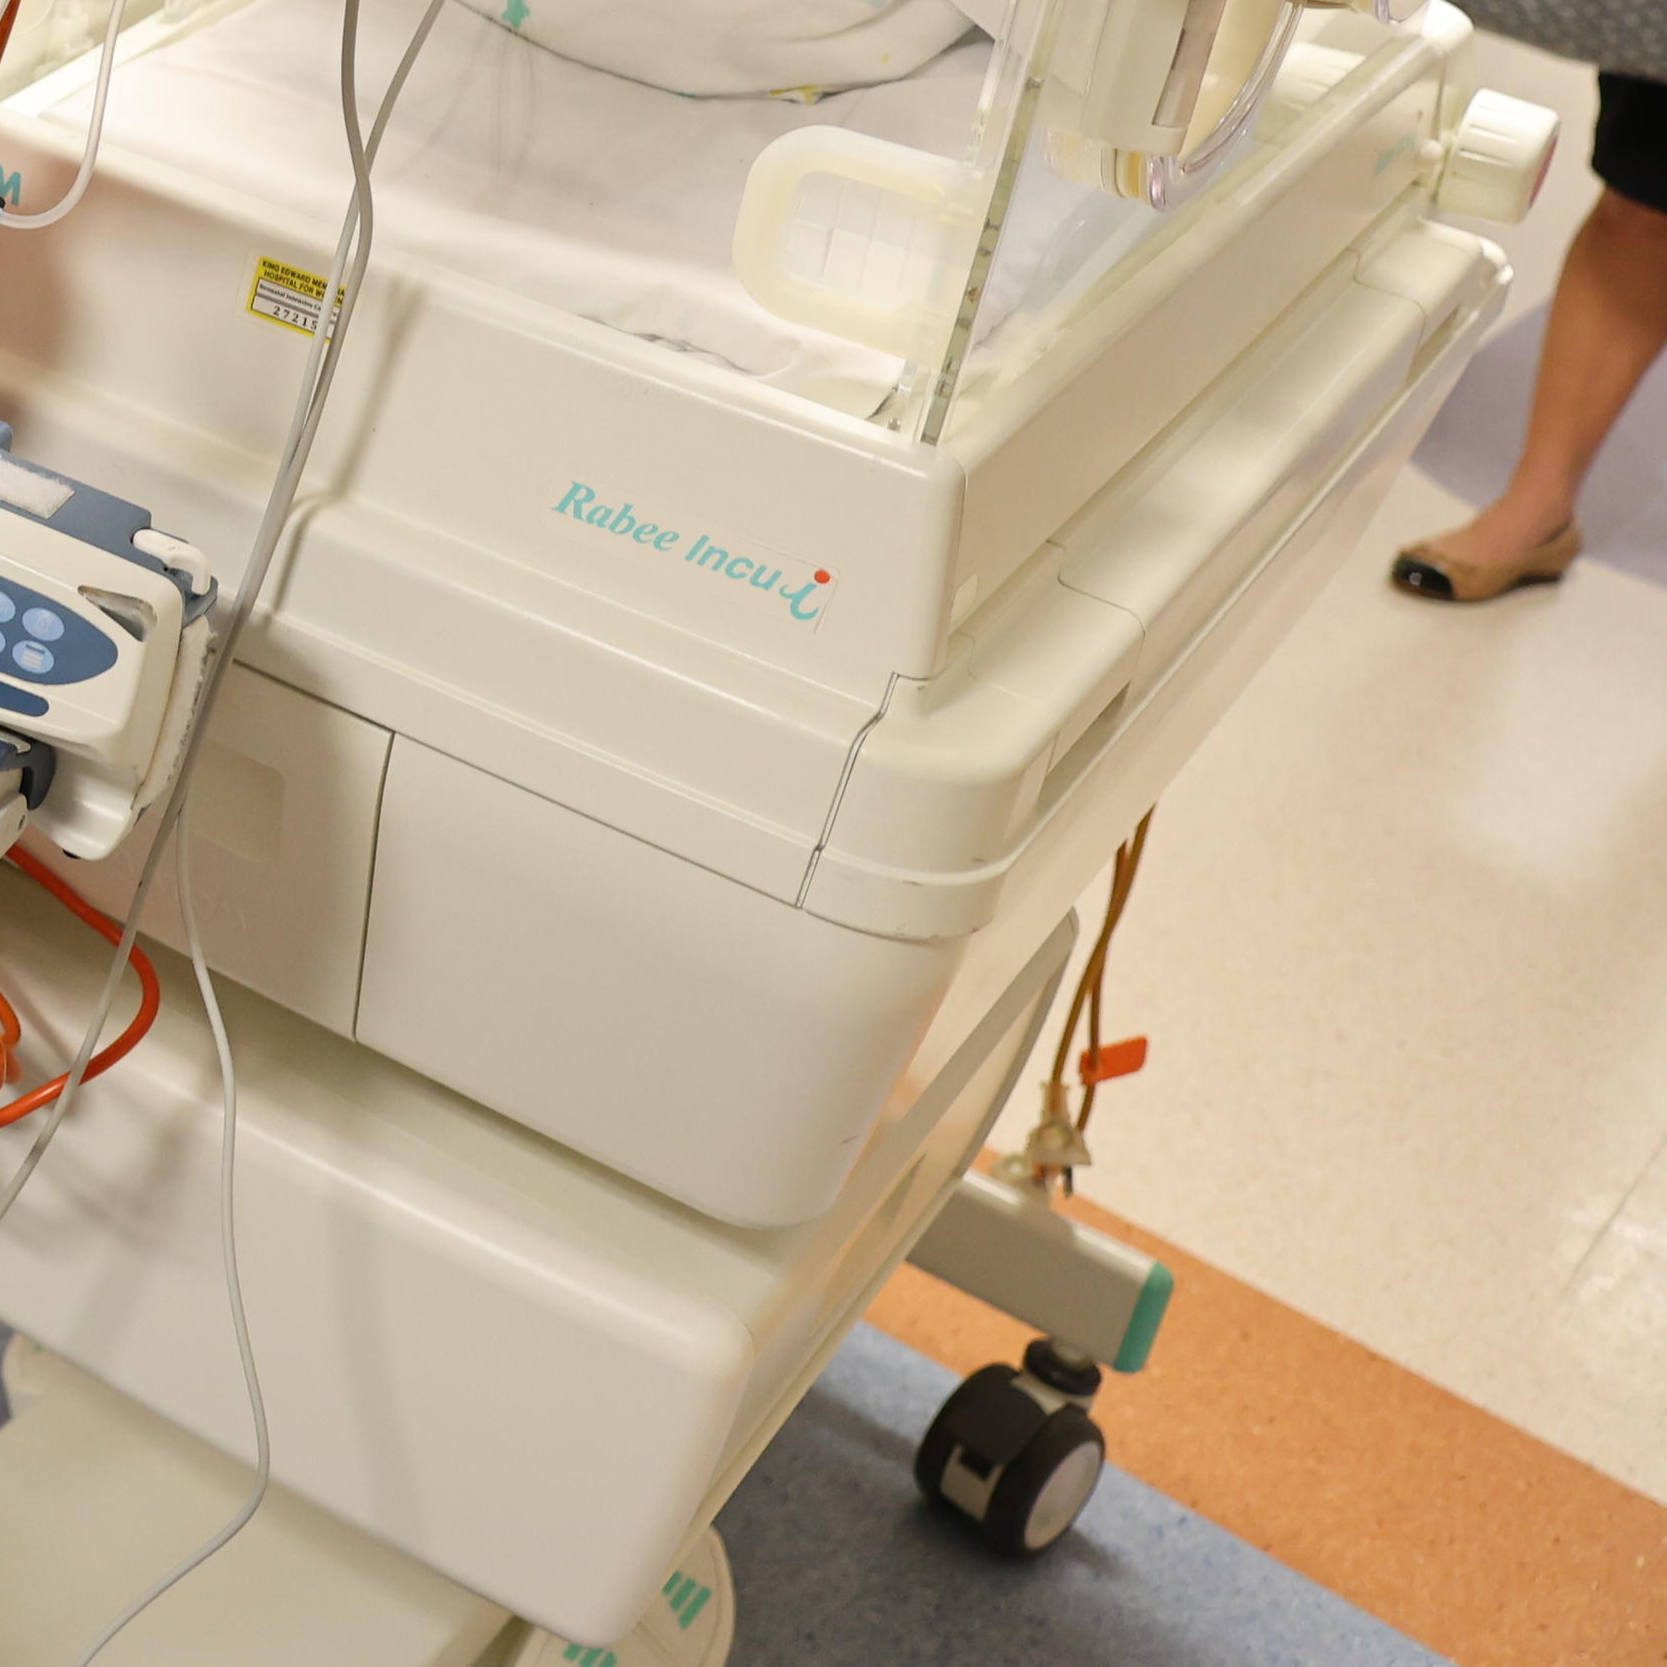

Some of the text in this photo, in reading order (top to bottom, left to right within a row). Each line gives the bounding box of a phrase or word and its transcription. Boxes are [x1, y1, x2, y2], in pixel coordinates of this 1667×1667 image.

[264, 270, 297, 288] HOSPITAL
[299, 281, 314, 294] FOR
[281, 266, 311, 283] EDWARD
[272, 305, 319, 331] 27215
[551, 480, 680, 552] Rabee
